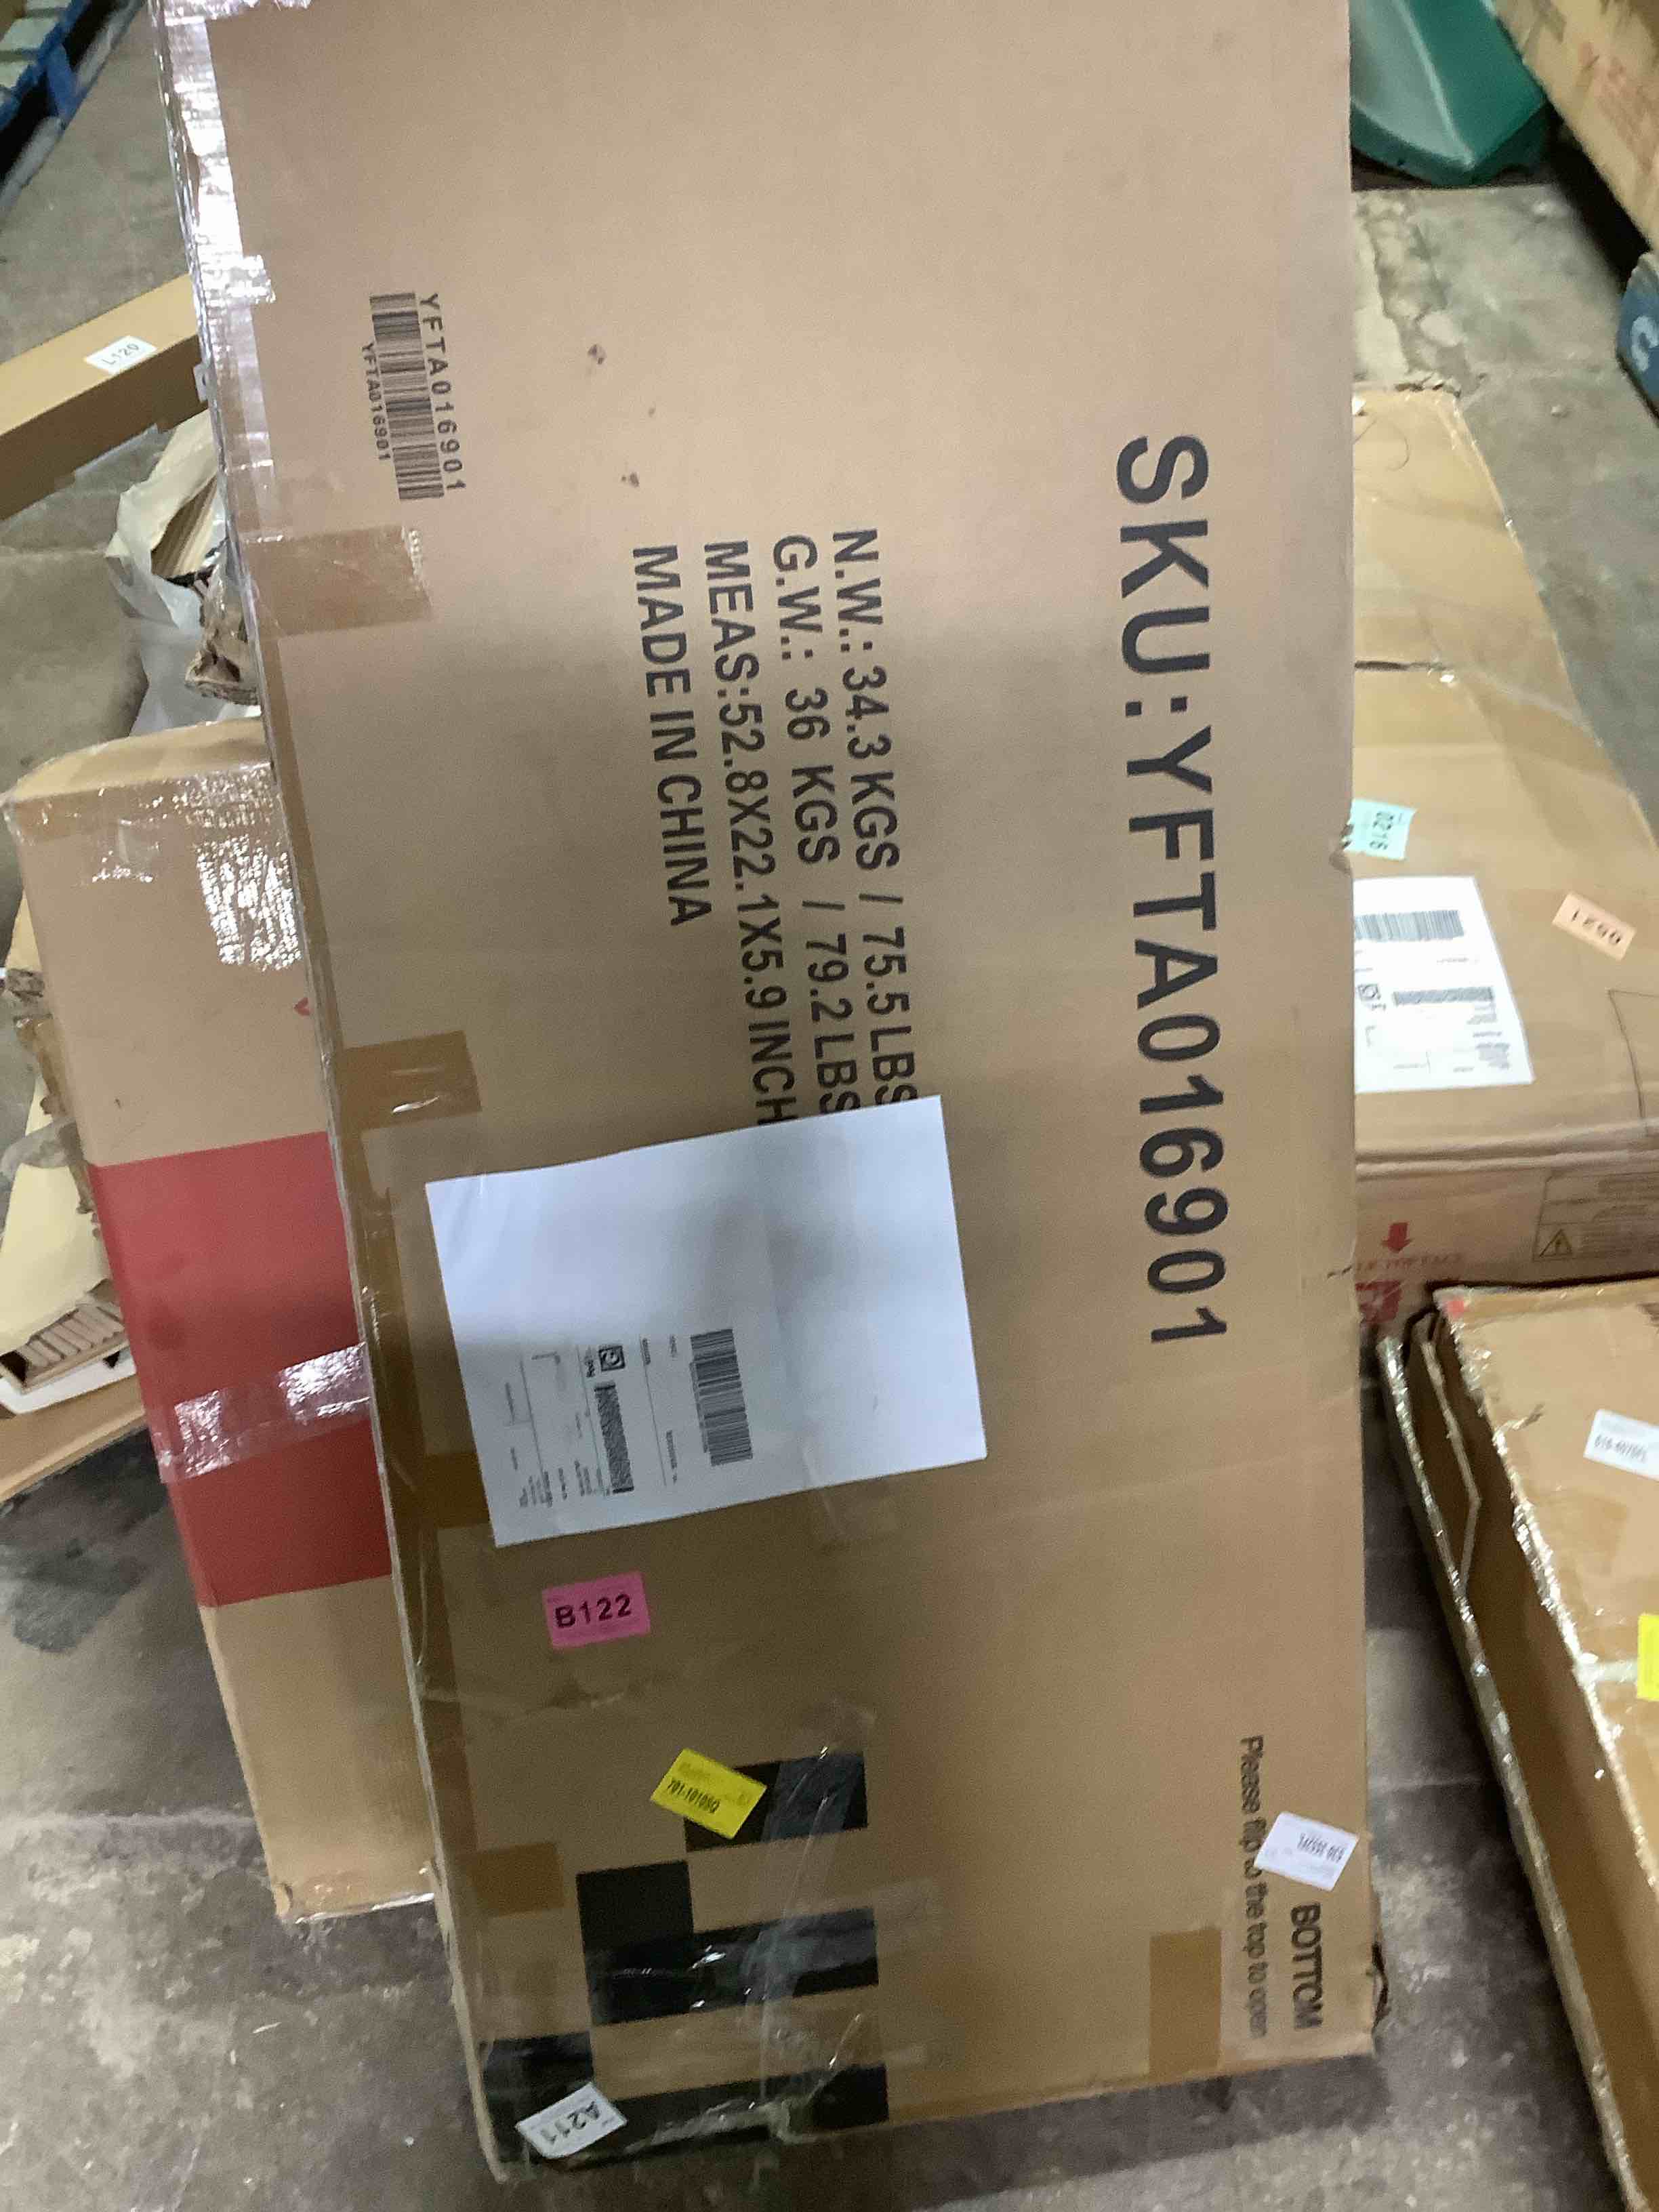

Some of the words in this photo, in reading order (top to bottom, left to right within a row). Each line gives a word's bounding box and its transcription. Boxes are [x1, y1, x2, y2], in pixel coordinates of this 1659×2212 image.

[362, 342, 391, 460] YFTA016901
[419, 293, 466, 491] YFTA016901
[632, 546, 692, 699] MADE
[773, 535, 823, 661] G.W.:
[832, 529, 884, 653] N.W.:
[650, 710, 698, 762] IN
[785, 688, 831, 741] 36
[842, 665, 892, 760] 34.3
[703, 540, 789, 1010] MEAS:52.8X22.1X5.9
[791, 764, 840, 865] KGS
[851, 771, 900, 871] KGS
[657, 775, 712, 926] CHINA
[858, 893, 903, 905] /
[1117, 436, 1229, 1343] SKU:YFTA016901
[802, 900, 846, 912] /
[806, 933, 853, 1024] 79.2
[863, 926, 910, 1015] 75.5
[555, 1594, 632, 1628] B122
[1241, 1736, 1264, 1814] Please
[1242, 1922, 1267, 1959] top
[1246, 1961, 1269, 1984] to
[1291, 1903, 1324, 2029] BOTTOM
